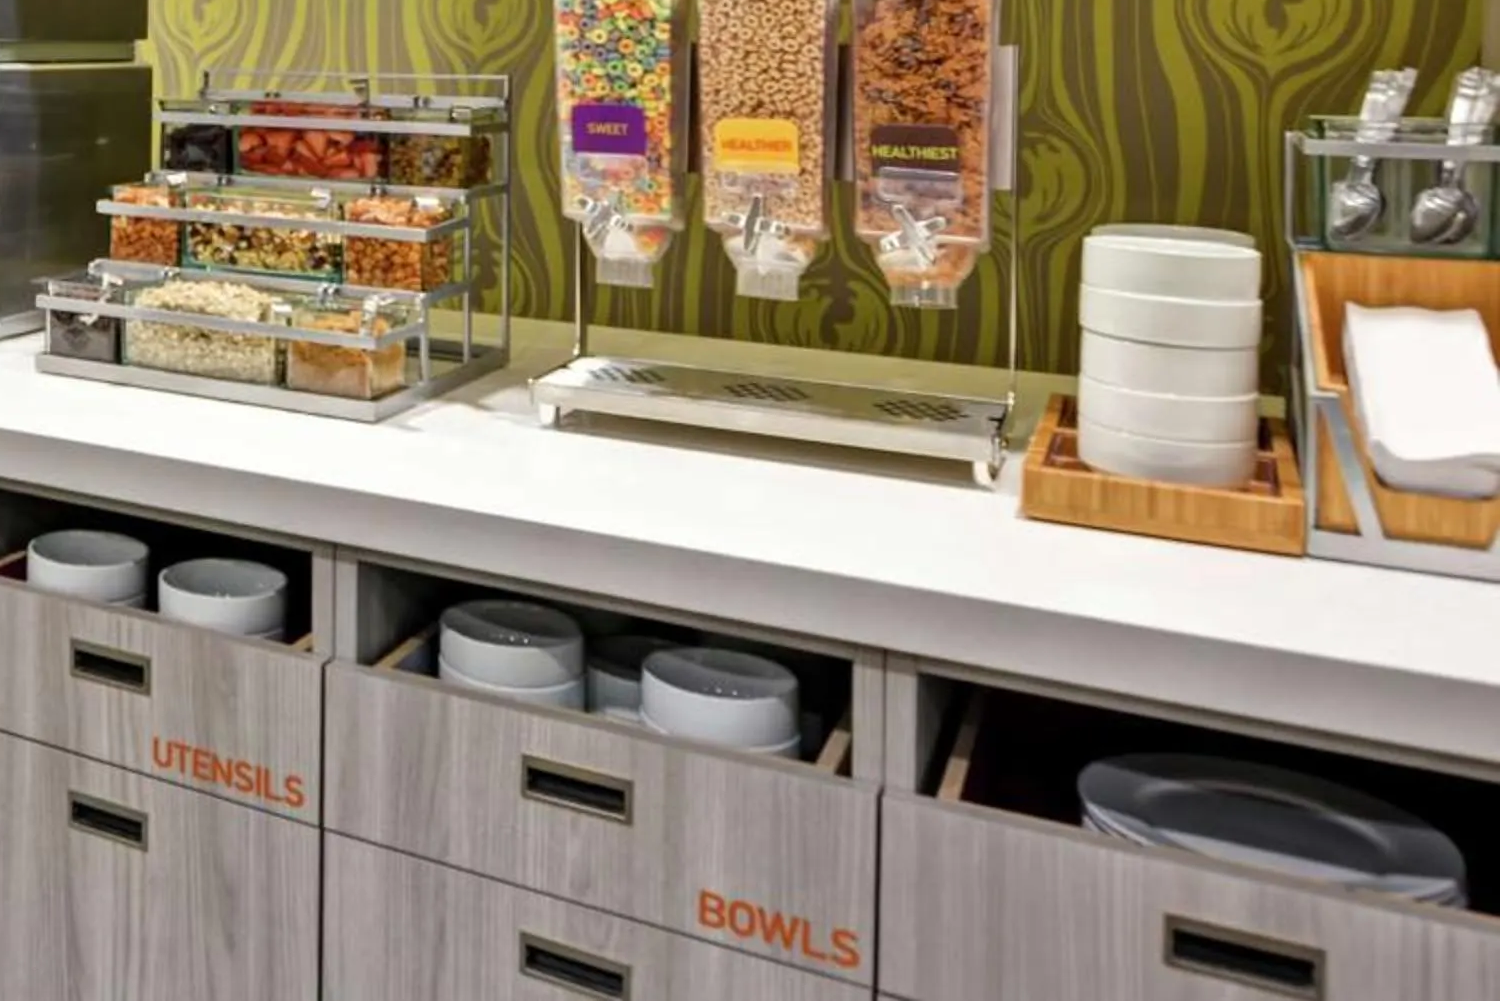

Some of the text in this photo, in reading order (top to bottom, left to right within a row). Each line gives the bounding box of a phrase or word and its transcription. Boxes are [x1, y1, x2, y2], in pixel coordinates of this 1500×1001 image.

[586, 121, 628, 136] SWEET
[871, 145, 959, 160] HEALTHIEST
[151, 736, 306, 808] UTENSILS
[697, 888, 861, 970] BOWLS
